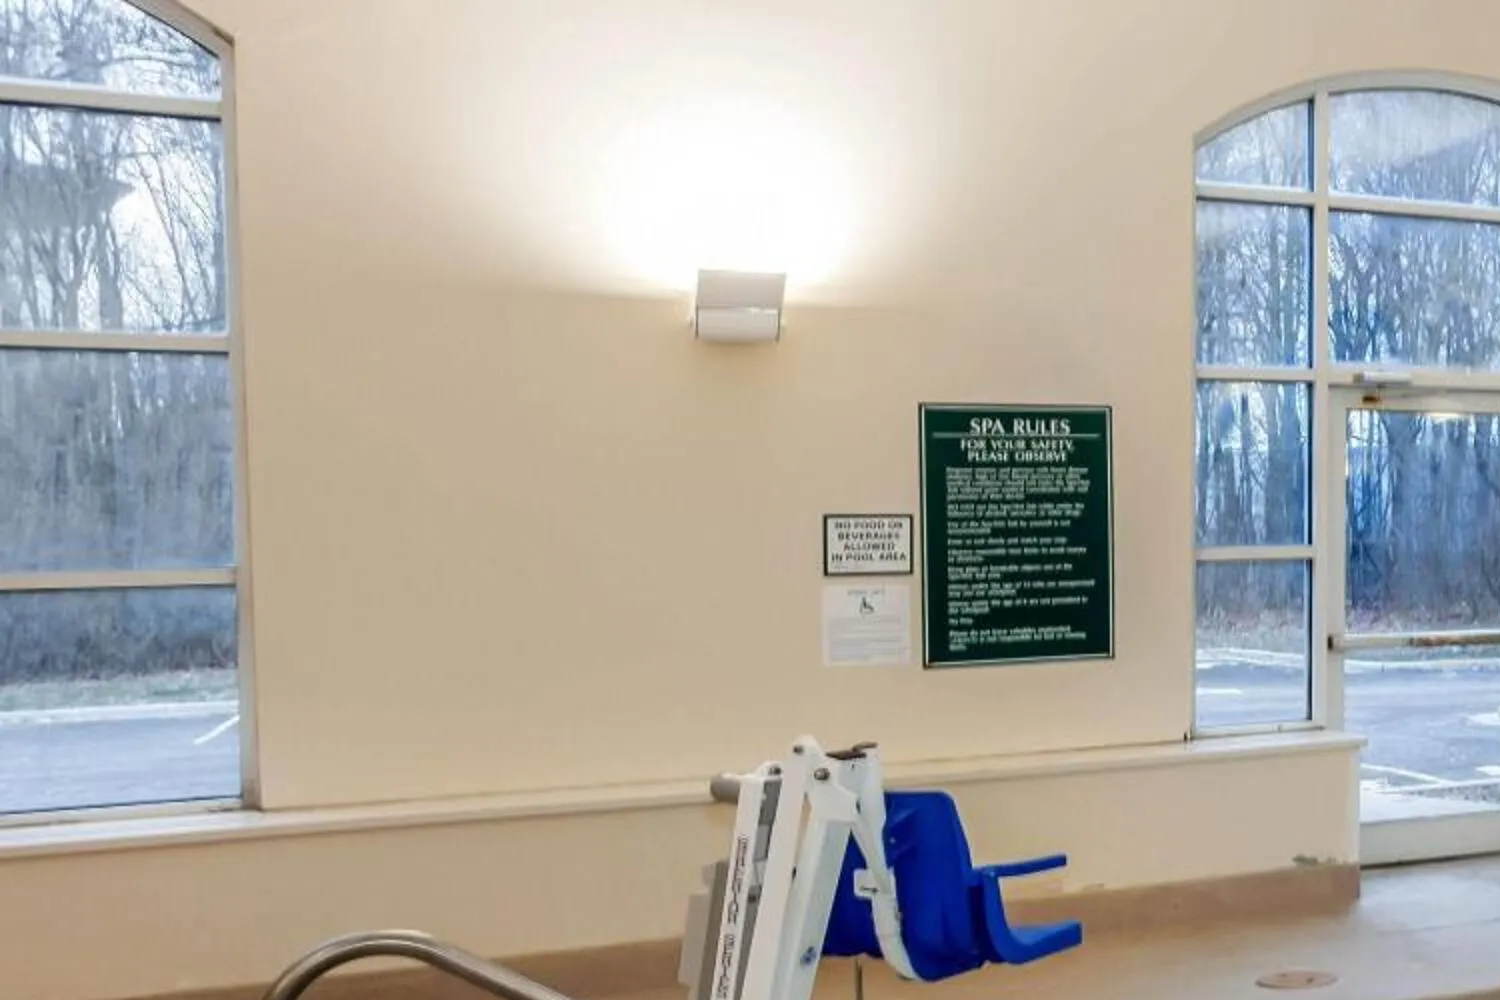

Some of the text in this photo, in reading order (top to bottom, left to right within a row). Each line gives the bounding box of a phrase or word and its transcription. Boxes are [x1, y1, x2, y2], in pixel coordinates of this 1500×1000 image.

[969, 417, 1071, 435] SPA RULES
[960, 439, 986, 451] FOR
[991, 439, 1027, 451] YOUR
[967, 450, 1067, 462] PLEASE OBSERVE
[834, 521, 851, 530] NO
[853, 521, 885, 530] FOOD
[843, 542, 895, 551] ALLOWED
[831, 551, 907, 562] IN POOL AREA
